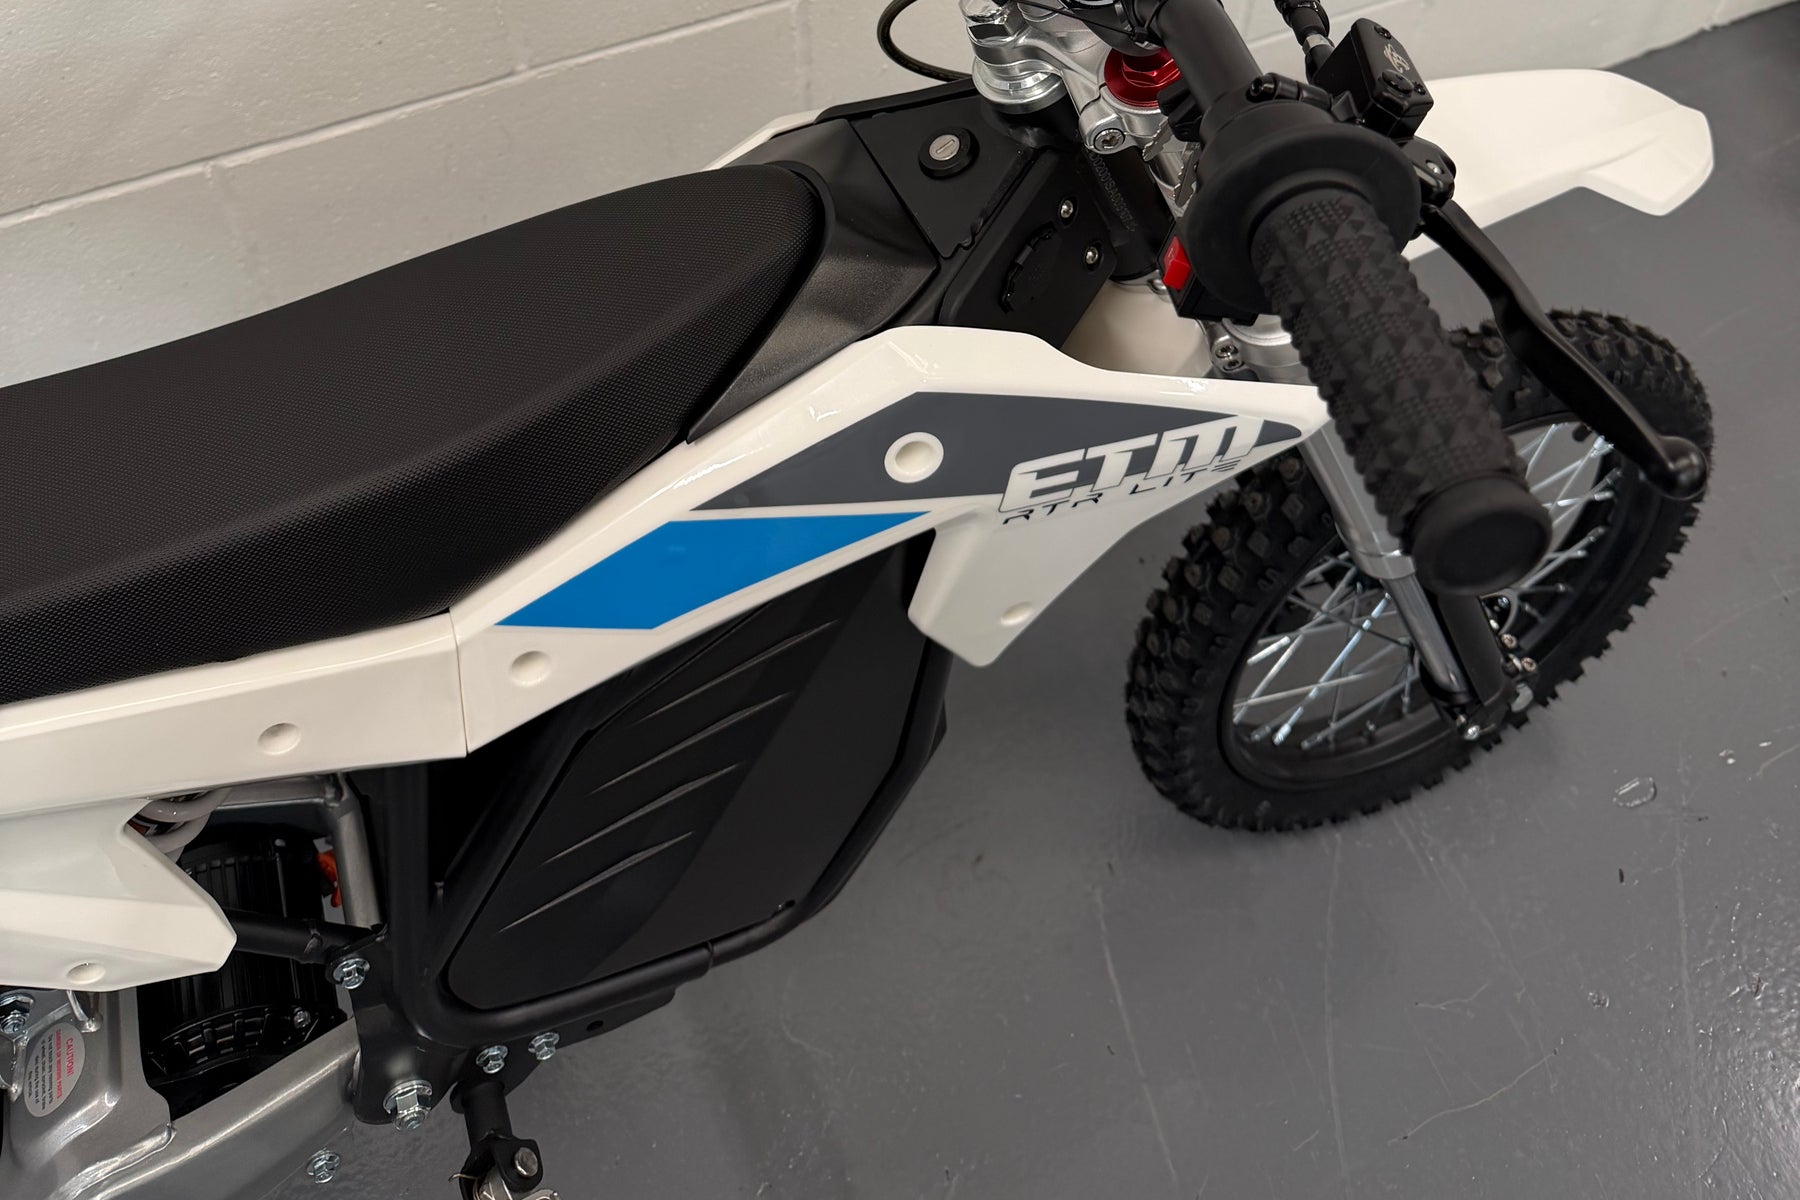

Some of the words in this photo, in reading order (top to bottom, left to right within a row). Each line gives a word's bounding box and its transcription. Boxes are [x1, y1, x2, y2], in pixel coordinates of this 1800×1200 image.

[998, 414, 1265, 512] ETM
[1002, 492, 1104, 525] RTR
[1129, 458, 1241, 495] LITE
[66, 1037, 74, 1077] CAUTION!
